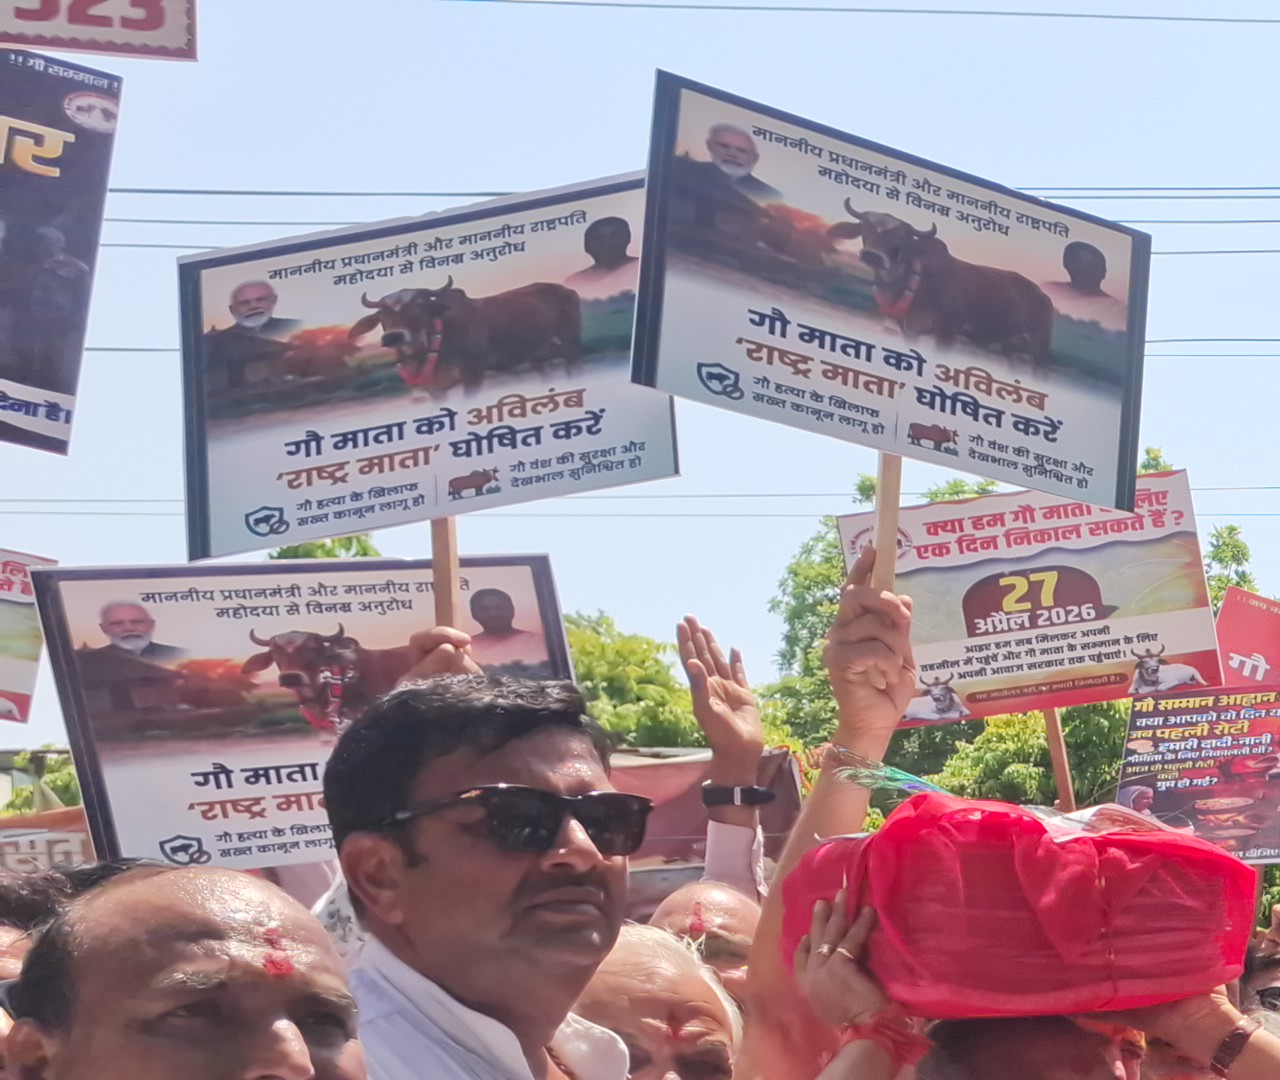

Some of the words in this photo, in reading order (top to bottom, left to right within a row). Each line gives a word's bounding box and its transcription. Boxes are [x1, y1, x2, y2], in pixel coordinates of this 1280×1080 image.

[751, 125, 823, 159] माननीय
[827, 150, 907, 186] प्रधानमंत्री
[912, 177, 942, 197] और
[946, 189, 1011, 220] माननीय
[817, 165, 882, 196] महोदया
[884, 185, 901, 202] से
[955, 209, 1011, 236] अनुरोध
[268, 258, 336, 281] माननीय
[341, 244, 419, 269] प्रधानमंत्री
[423, 237, 453, 253] और
[458, 223, 526, 246] माननीय
[748, 307, 791, 339] गौ
[797, 323, 876, 363] माता
[882, 347, 927, 377] को
[934, 363, 1048, 411] अविलंब
[285, 430, 324, 459] गौ
[330, 421, 407, 451] माता
[413, 408, 458, 435] को
[466, 387, 586, 426] अविलंब
[449, 425, 543, 459] घोषित
[550, 408, 606, 440] करें
[914, 384, 1005, 429] घोषित
[1010, 411, 1064, 444] करें
[914, 544, 952, 560] एक
[955, 535, 998, 555] दिन
[1002, 523, 1082, 549] निकाल
[1087, 514, 1146, 537] सकते
[1148, 508, 1168, 529] हैं
[1172, 510, 1184, 526] ?
[923, 518, 964, 537] क्या
[969, 511, 1006, 530] हम
[1010, 505, 1036, 525] गौ
[999, 571, 1059, 613] 27
[974, 611, 1030, 634] अप्रैल
[1036, 604, 1096, 625] 2026
[1228, 651, 1270, 681] गौ
[1134, 697, 1156, 713] गौ
[1158, 695, 1215, 710] सम्मान
[191, 763, 234, 790] गौ
[240, 762, 319, 786] माता
